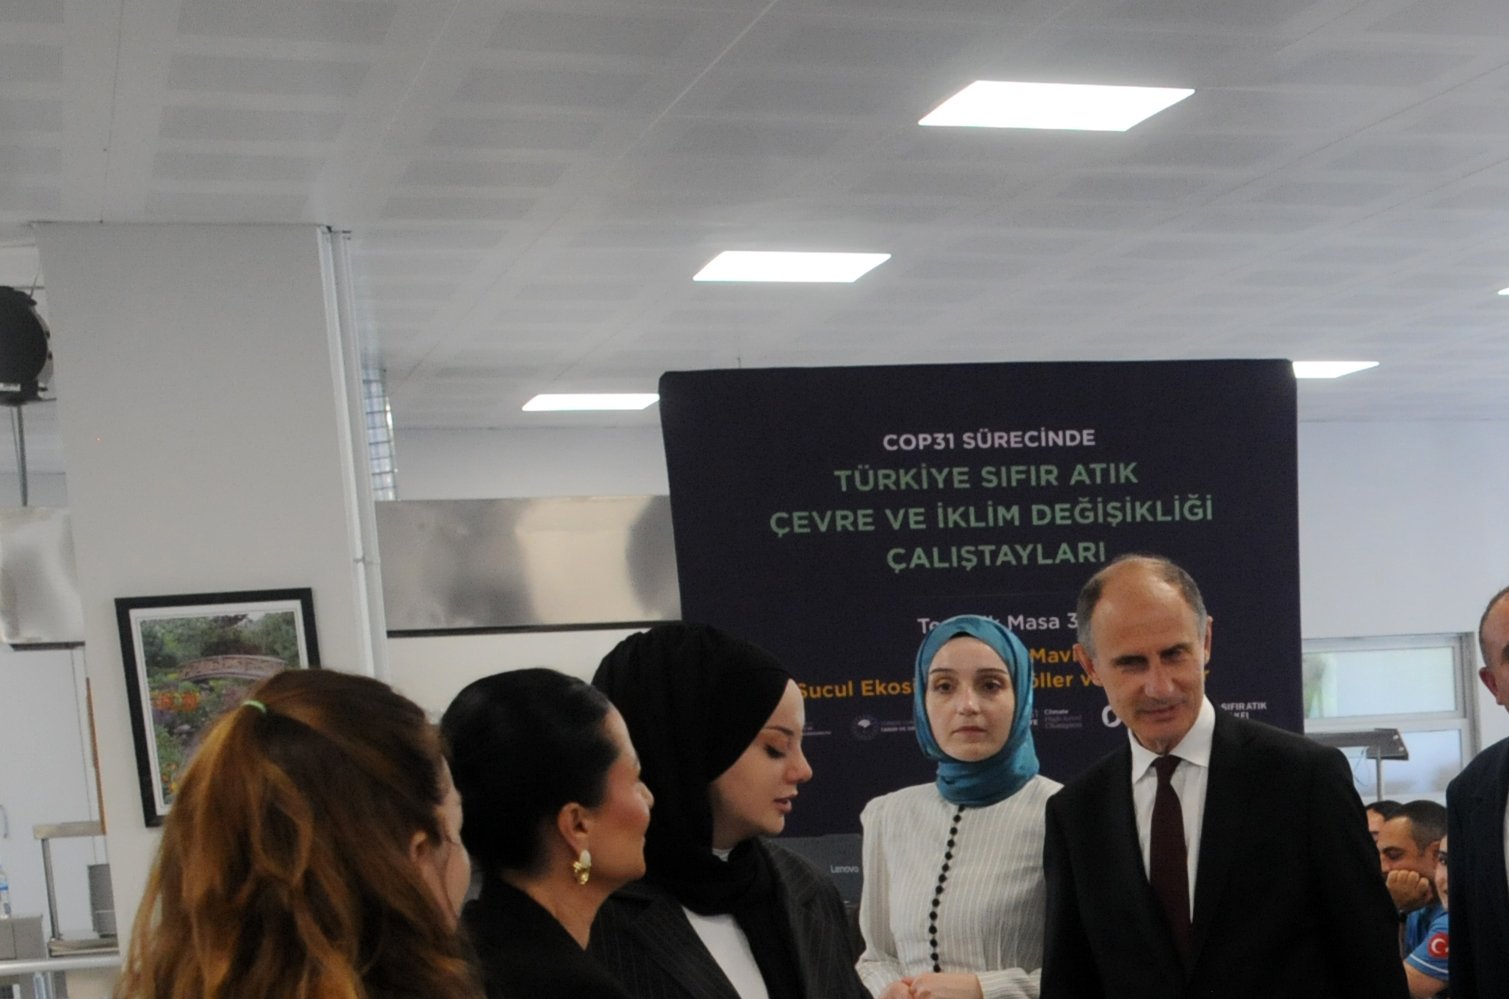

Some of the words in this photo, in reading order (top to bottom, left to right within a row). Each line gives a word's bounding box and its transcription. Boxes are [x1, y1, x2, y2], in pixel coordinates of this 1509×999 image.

[883, 433, 956, 452] COP31
[962, 428, 1097, 450] SÜRECİNDE
[834, 464, 971, 493] TÜRKİYE
[981, 466, 1059, 489] SIFIR
[1069, 463, 1139, 486] ATIK
[770, 510, 876, 538] ÇEVRE
[885, 509, 927, 531] VE
[937, 502, 1021, 529] İKLİM
[1031, 495, 1214, 528] DEĞİŞİKLİĞİ
[887, 541, 1106, 574] ÇALIŞTAYLARI
[1007, 614, 1060, 632] Masa
[799, 680, 854, 699] Sucul
